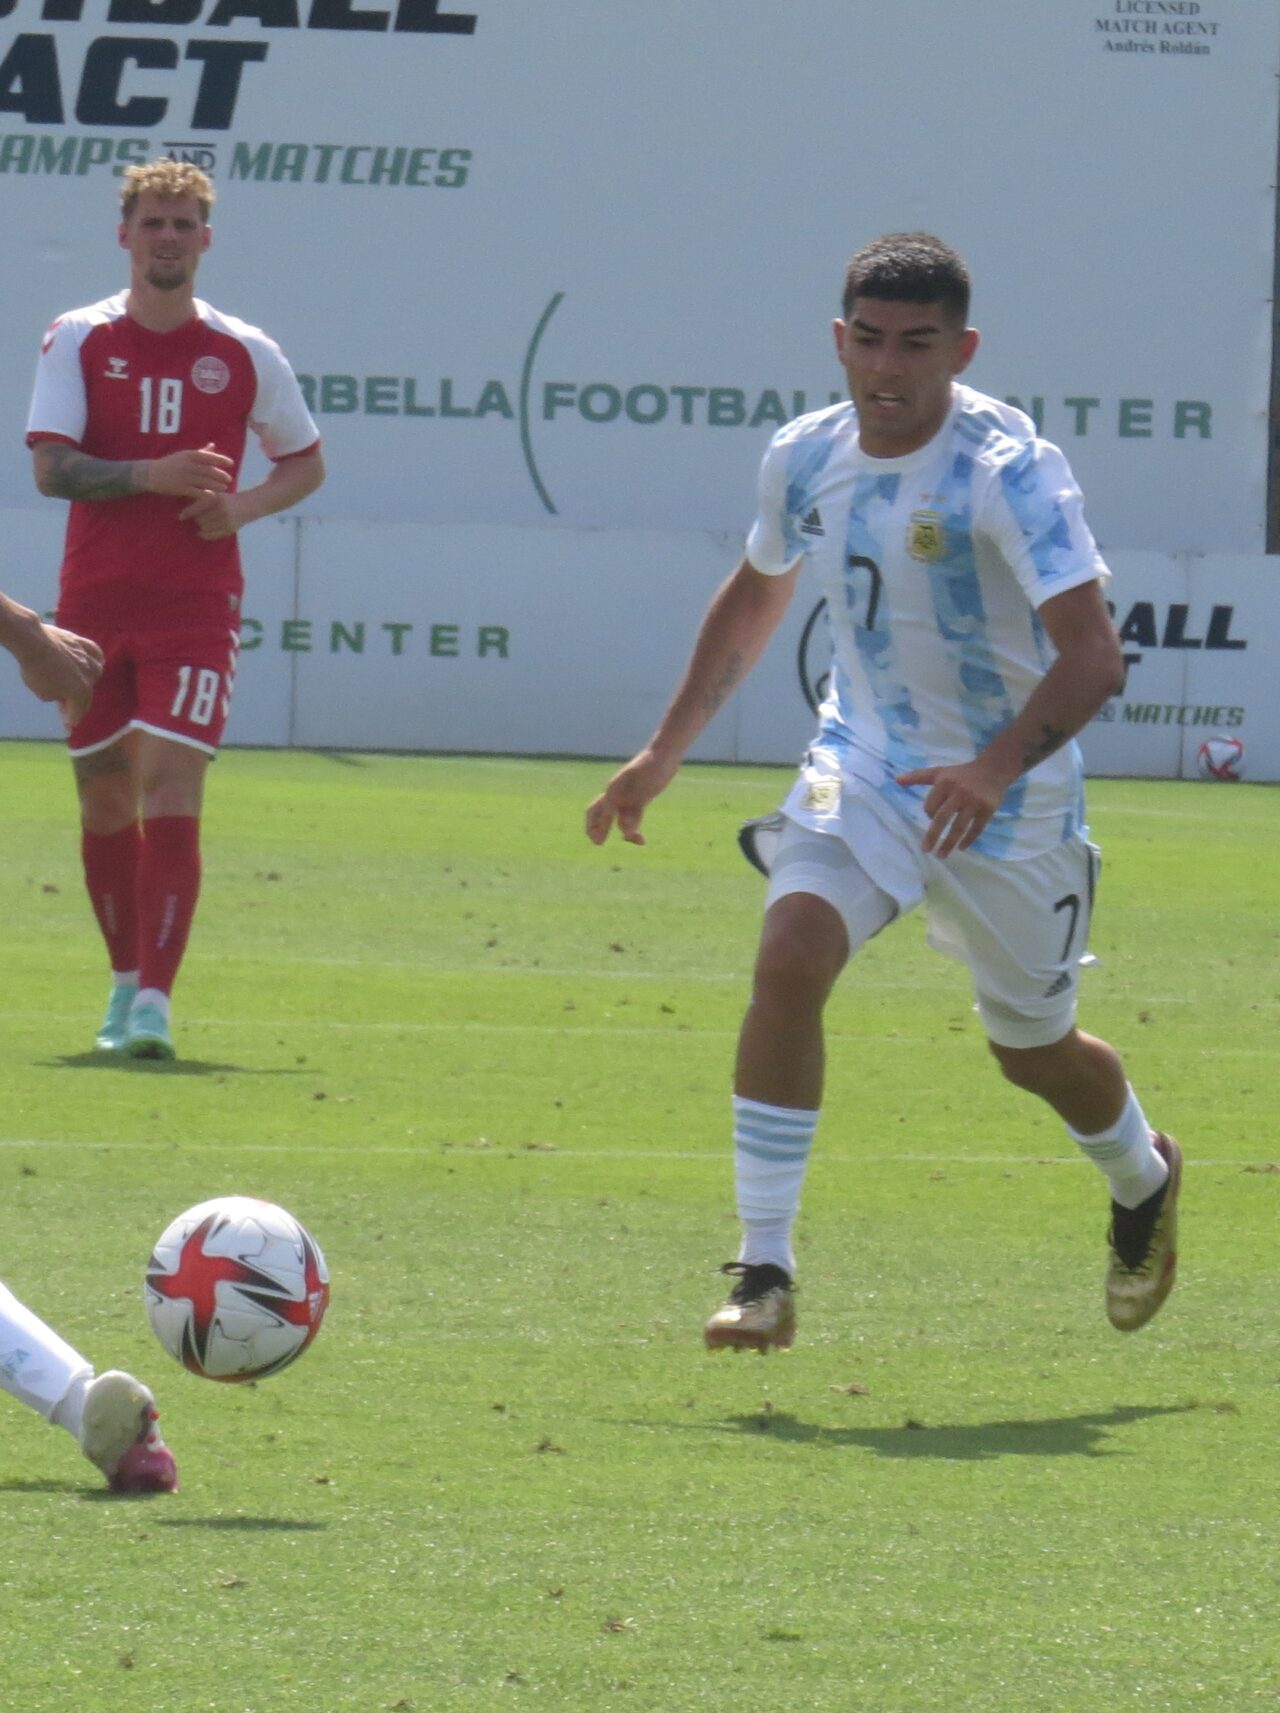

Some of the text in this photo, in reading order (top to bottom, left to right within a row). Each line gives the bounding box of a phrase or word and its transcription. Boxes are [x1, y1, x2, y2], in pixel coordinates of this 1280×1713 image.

[1094, 18, 1220, 36] MATCH AGENT
[1116, 0, 1200, 15] LICENSED
[229, 141, 473, 188] MATCHES
[140, 377, 183, 434] 18
[542, 382, 842, 428] FOOTBA
[848, 555, 883, 630] 7
[1107, 600, 1248, 650] ALL
[171, 665, 219, 727] 18
[1124, 703, 1245, 728] MATCHES
[1053, 893, 1080, 961] 7
